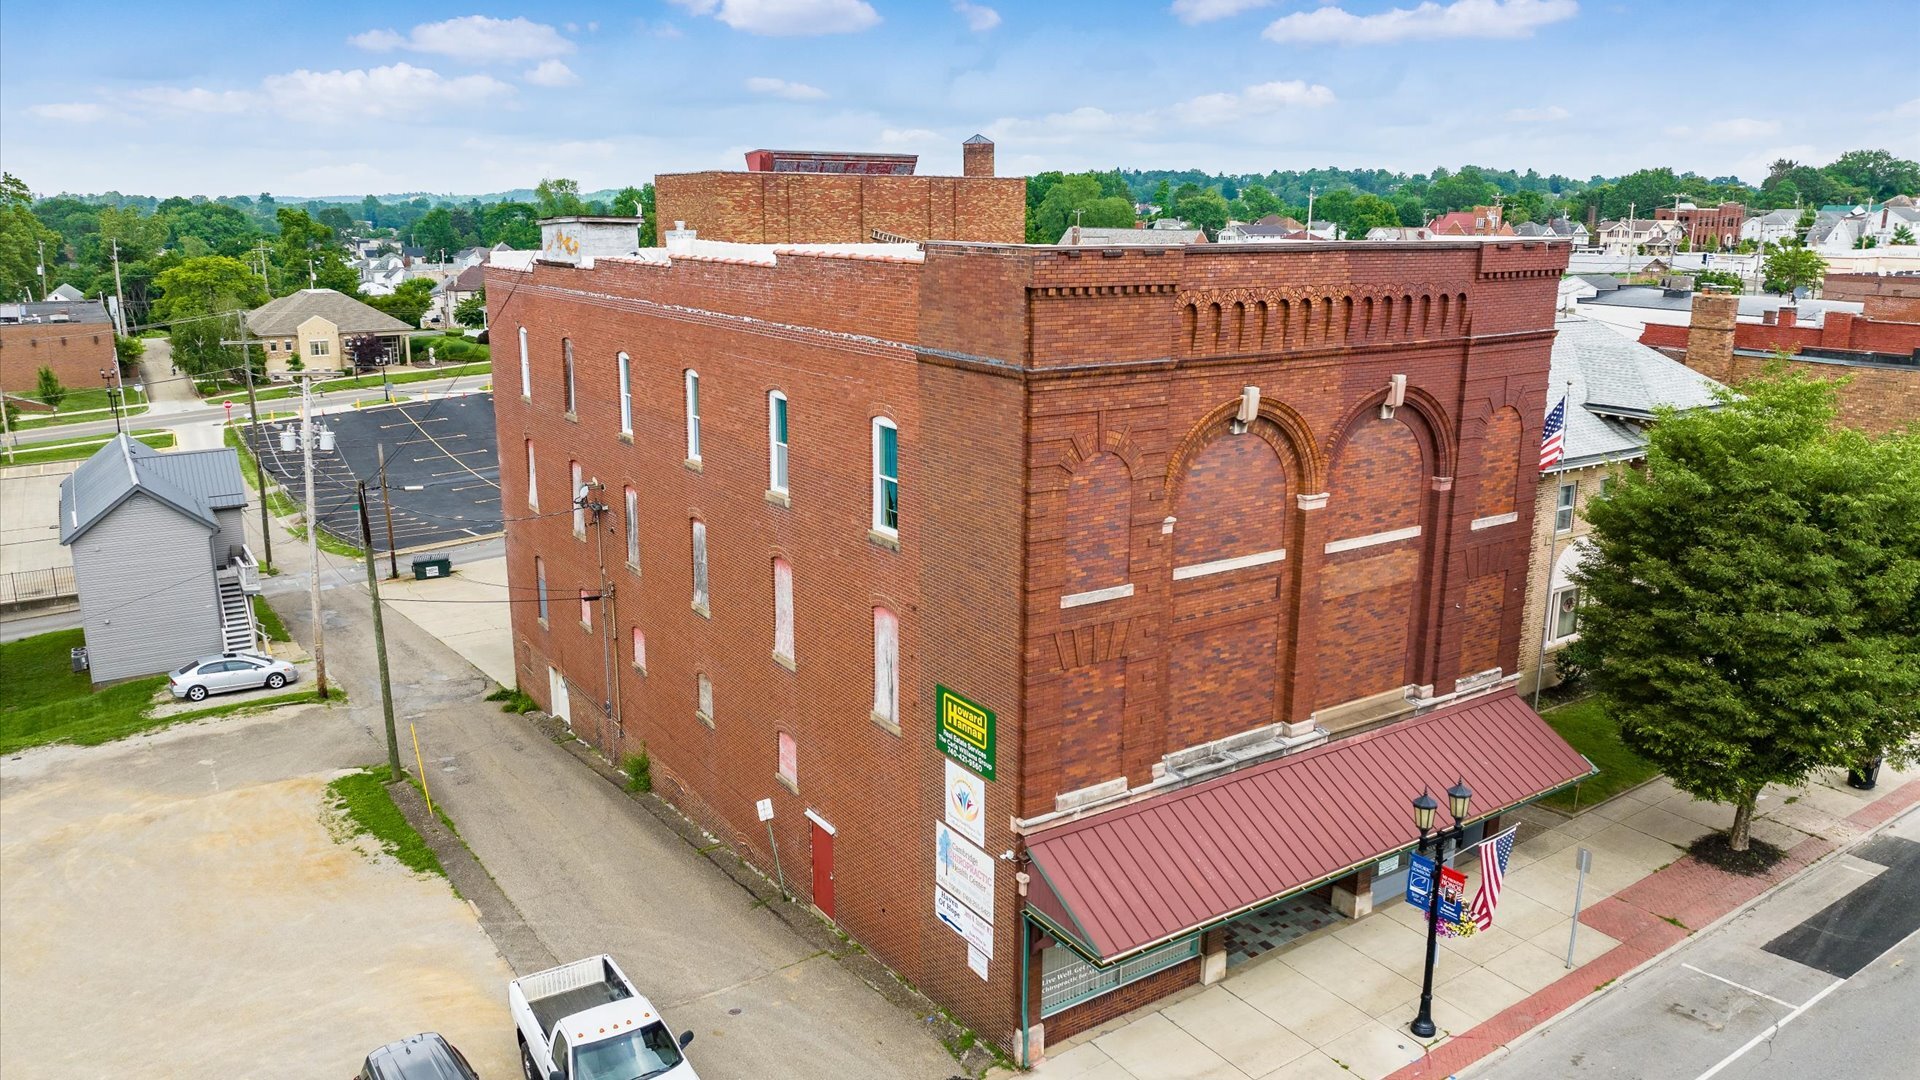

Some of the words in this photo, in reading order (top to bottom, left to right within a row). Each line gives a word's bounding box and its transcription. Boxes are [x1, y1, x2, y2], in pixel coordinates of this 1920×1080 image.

[947, 701, 983, 727] Howard
[938, 733, 947, 744] The
[958, 745, 978, 761] Williams
[978, 756, 993, 771] Group
[943, 728, 952, 740] Real
[953, 734, 967, 748] Estate
[967, 742, 987, 760] Services
[952, 842, 978, 866] Cambridge
[948, 848, 992, 886] CHIROPRACTIC
[952, 863, 969, 880] Health
[968, 874, 987, 893] Center
[938, 897, 946, 907] Of
[946, 902, 961, 919] Hope
[941, 890, 959, 909] Haven
[1041, 976, 1077, 994] Chiropractic
[1078, 972, 1088, 980] for
[1042, 977, 1056, 987] Live
[1074, 965, 1086, 974] Get
